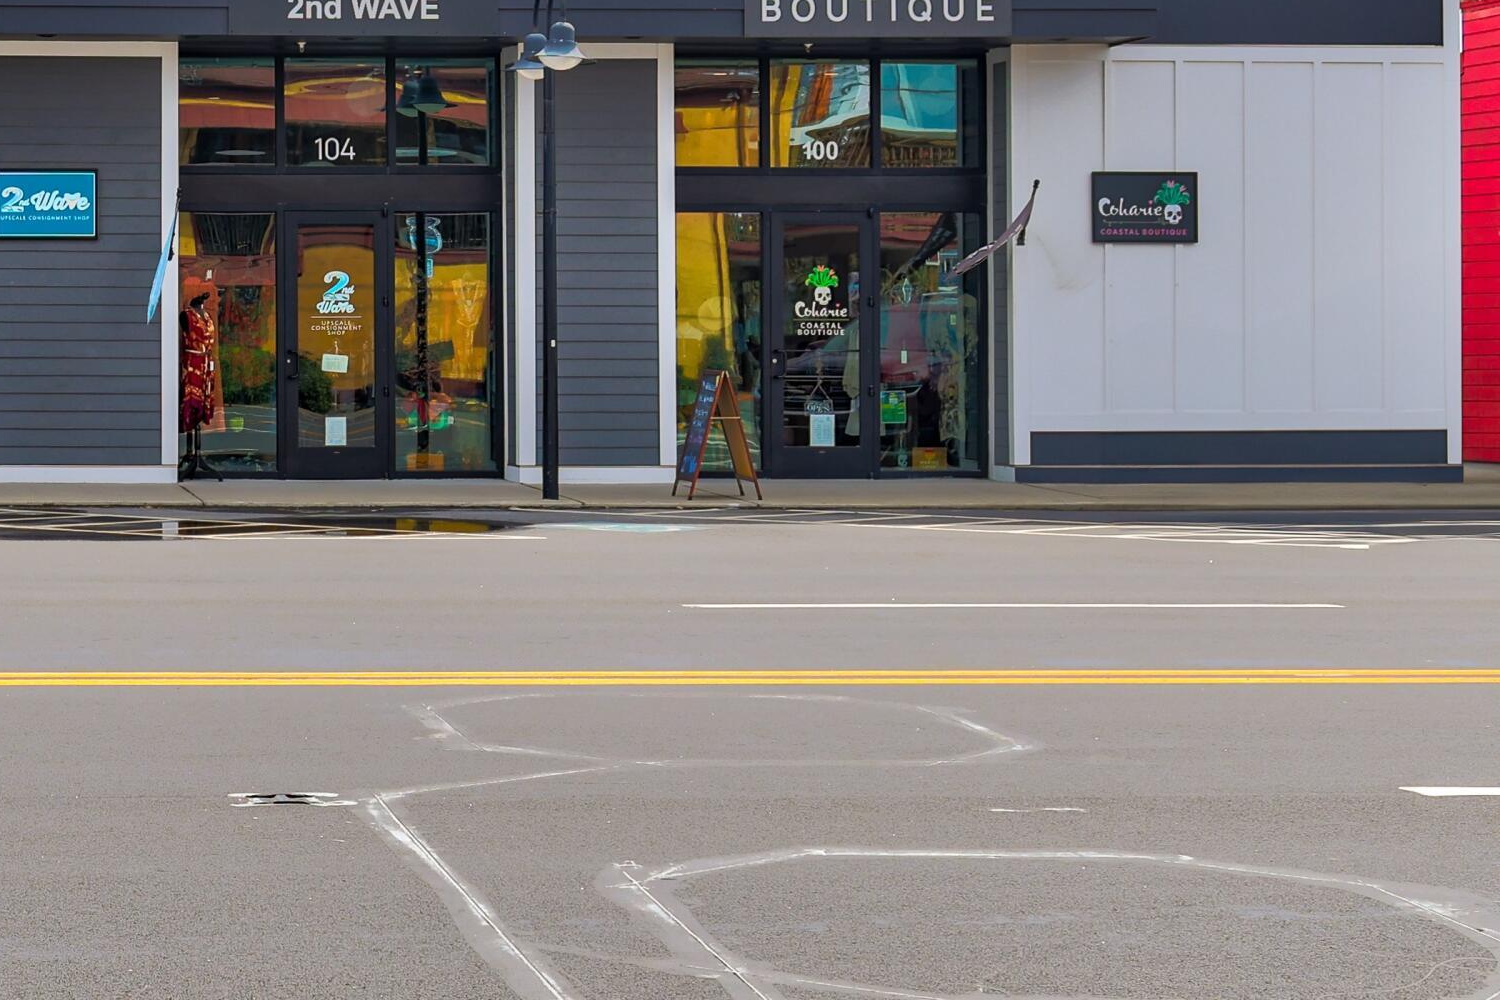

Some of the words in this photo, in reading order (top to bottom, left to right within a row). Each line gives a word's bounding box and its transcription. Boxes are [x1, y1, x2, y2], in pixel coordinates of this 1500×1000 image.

[314, 137, 356, 161] 104
[802, 141, 838, 161] 100
[30, 190, 91, 211] Wave
[1098, 197, 1162, 217] Coharie
[1100, 228, 1140, 236] COASTAL
[1141, 228, 1188, 236] BOUTIQUE
[323, 270, 355, 301] 2nd
[316, 300, 355, 314] Wave
[794, 301, 848, 318] Coharie
